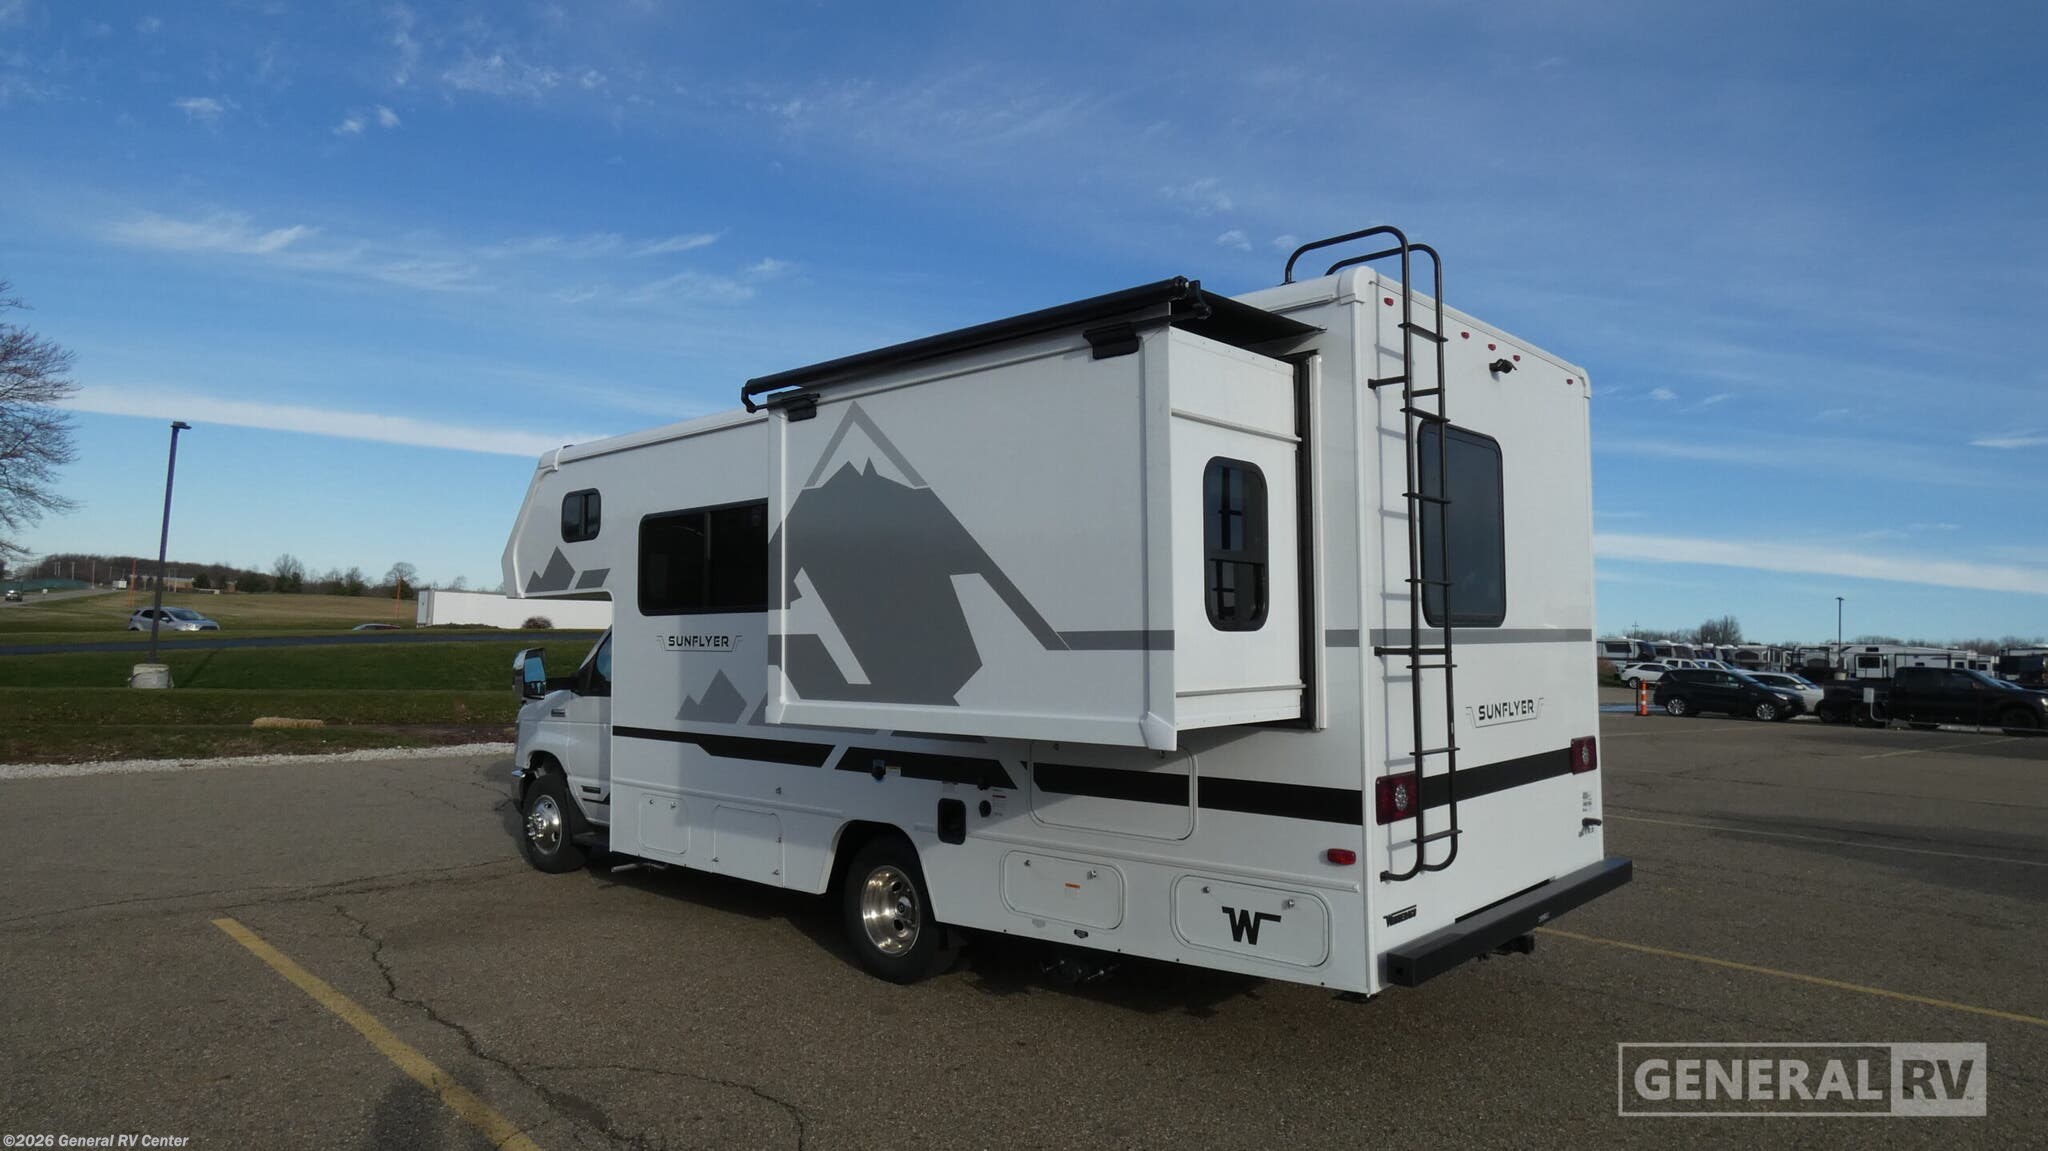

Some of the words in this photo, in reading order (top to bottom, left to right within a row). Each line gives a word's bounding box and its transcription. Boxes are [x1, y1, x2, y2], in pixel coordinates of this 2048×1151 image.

[668, 635, 729, 647] SUNFLYER
[1478, 699, 1534, 721] SUNFLYER
[1221, 906, 1282, 946] W
